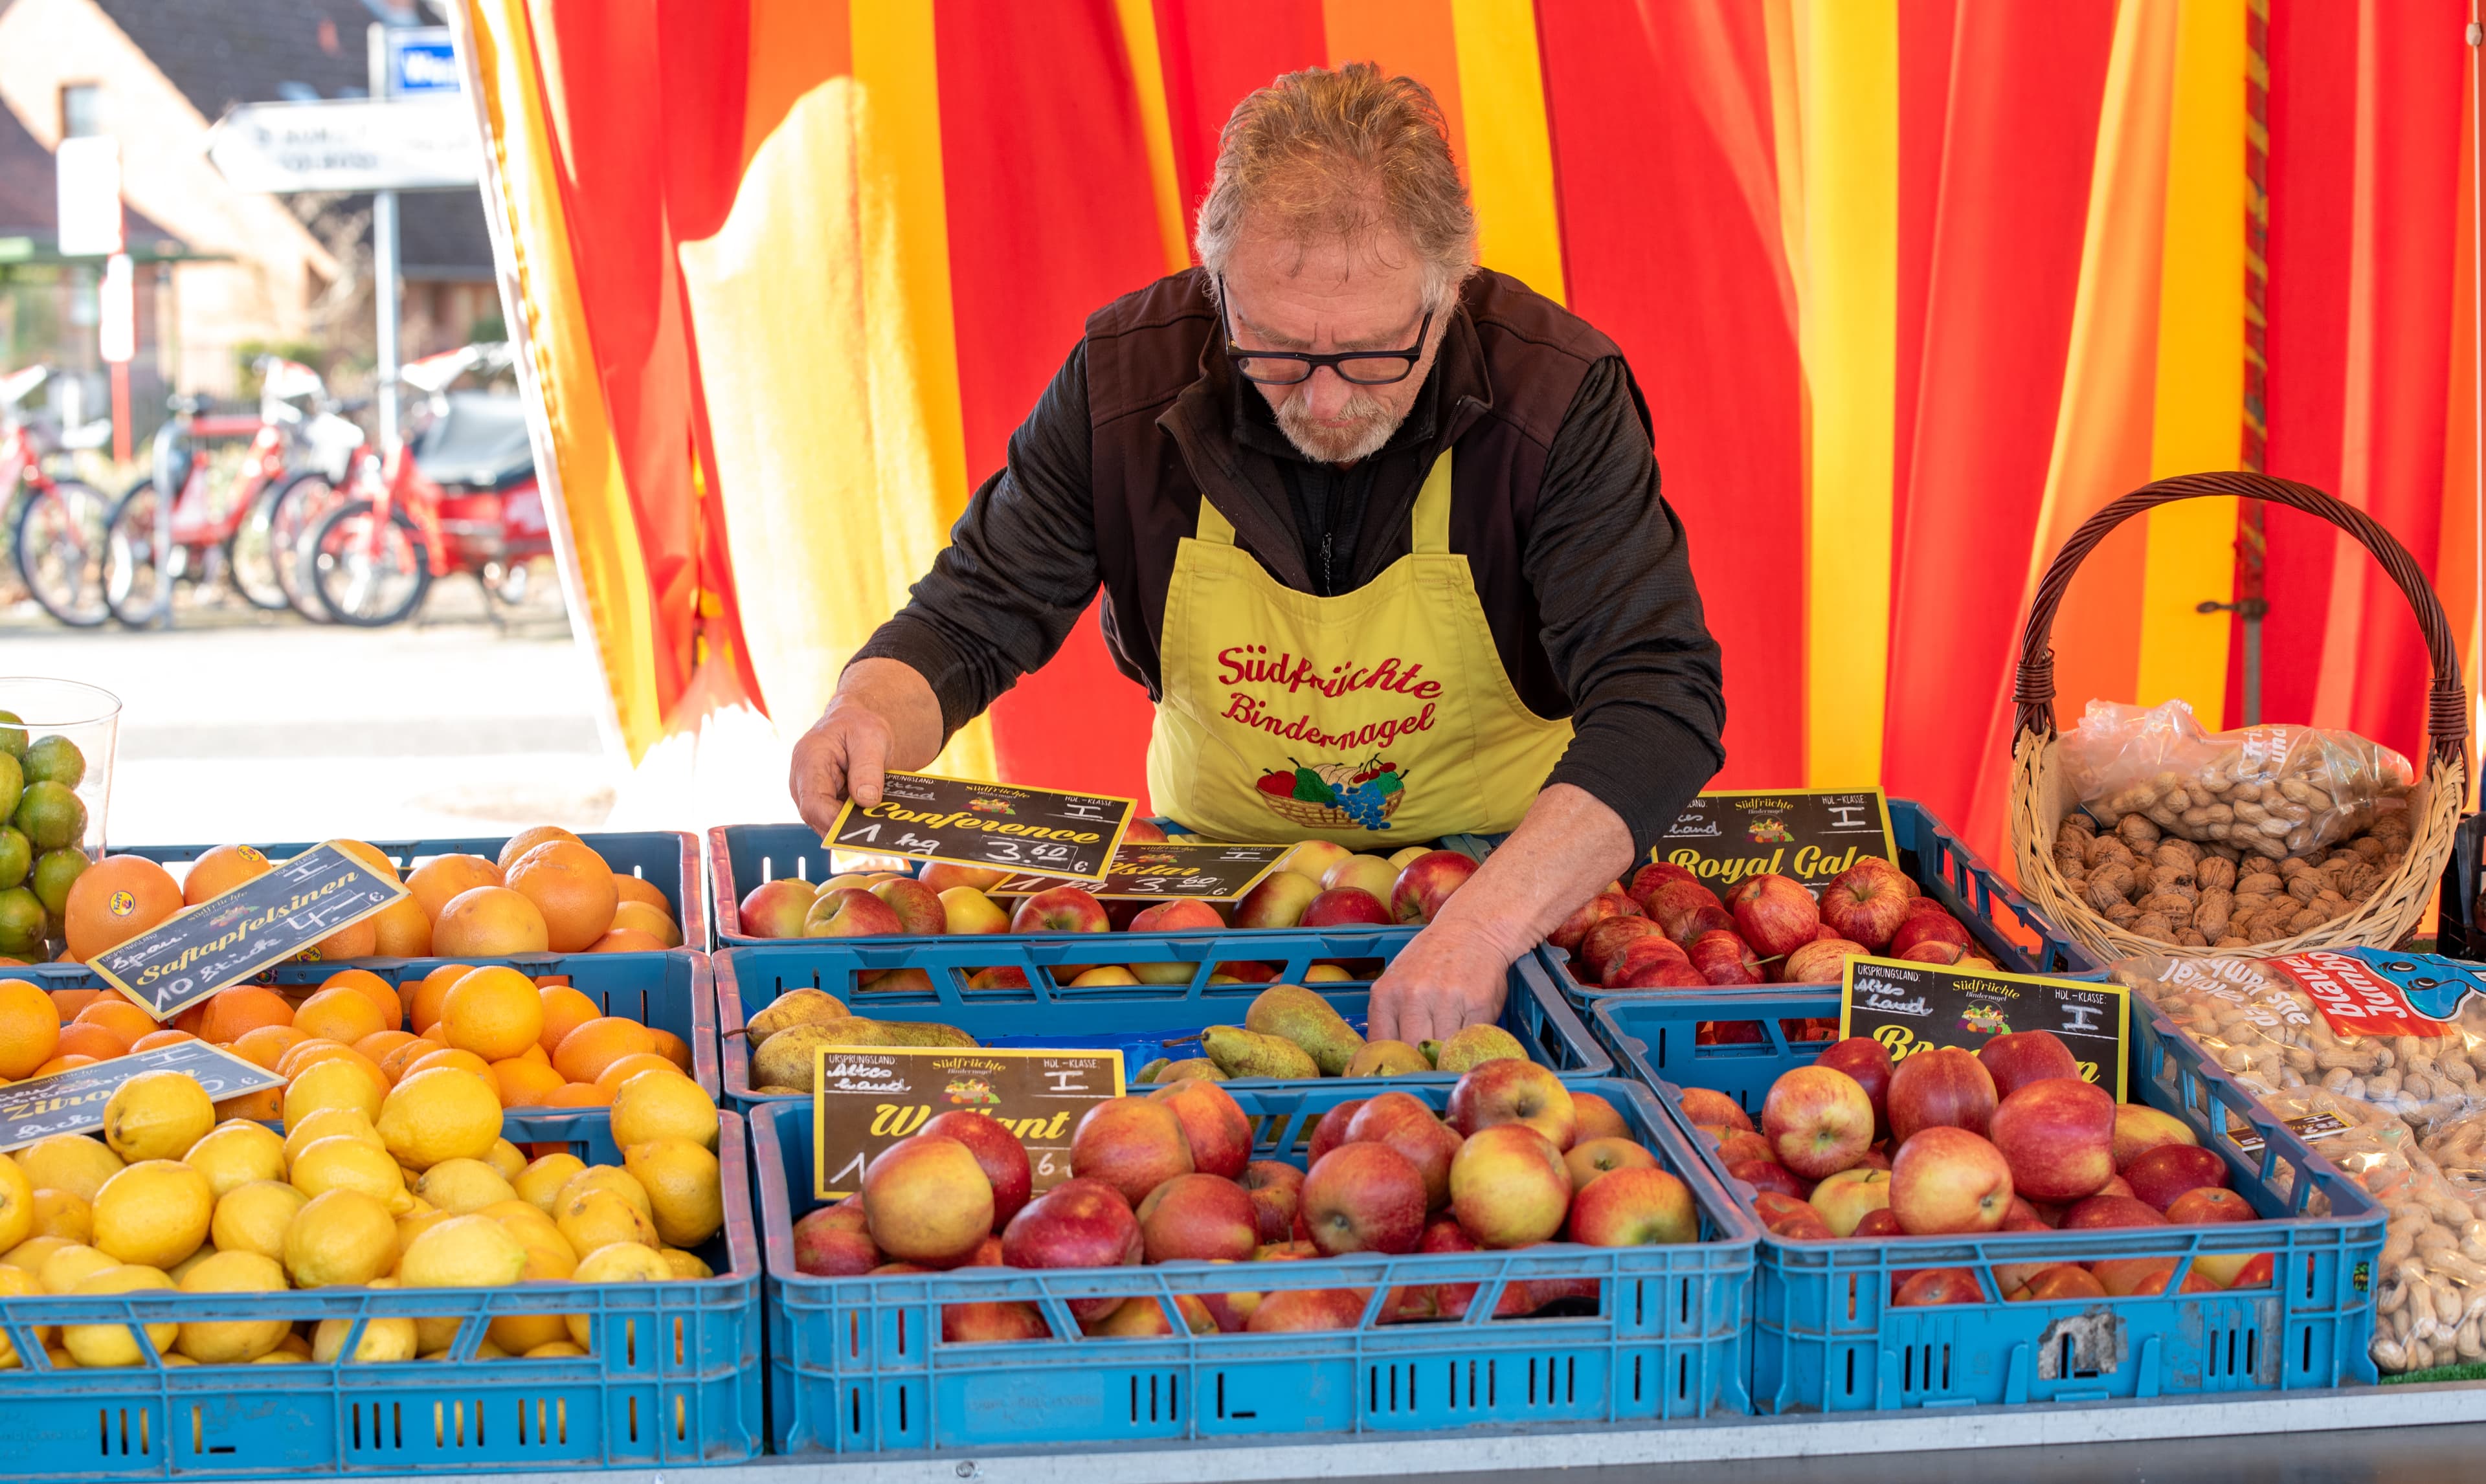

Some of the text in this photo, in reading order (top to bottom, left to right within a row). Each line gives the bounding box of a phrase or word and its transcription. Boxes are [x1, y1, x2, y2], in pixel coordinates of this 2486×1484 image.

[1218, 644, 1443, 700] Südfrüchte
[1221, 692, 1436, 751] Bindernagel
[1735, 797, 1794, 810] Südfrüchte
[1822, 795, 1867, 804] HDL.-KLASSE:
[1064, 803, 1103, 819] I
[1828, 806, 1866, 826] I
[862, 802, 1100, 844] Conference
[839, 823, 1088, 872] 1 kg 3.60 €
[1668, 845, 1877, 884] Royal Gal
[1001, 877, 1045, 891] 1
[1128, 875, 1218, 892] 3.60
[1213, 887, 1227, 896] €
[137, 872, 359, 986] Saftapfelsinen
[155, 977, 194, 1013] 10
[368, 891, 385, 902] €
[1858, 964, 1921, 982] URSPRUNGSLAND:
[1953, 979, 2020, 1000] Südfrüchte
[2055, 988, 2107, 1004] HDL.-KLASSE:
[2280, 956, 2367, 1018] blaue
[2308, 952, 2408, 1019] Jumbo
[1965, 991, 2008, 1002] Bindernagel
[2061, 1004, 2103, 1030] I
[2267, 991, 2311, 1024] aus
[829, 1054, 897, 1065] URSPRUNGSLAND:
[932, 1058, 1006, 1072] Südfrüchte
[1044, 1059, 1101, 1070] HDL.-KLASSE:
[1044, 1070, 1089, 1091] I
[829, 1151, 866, 1184] 1
